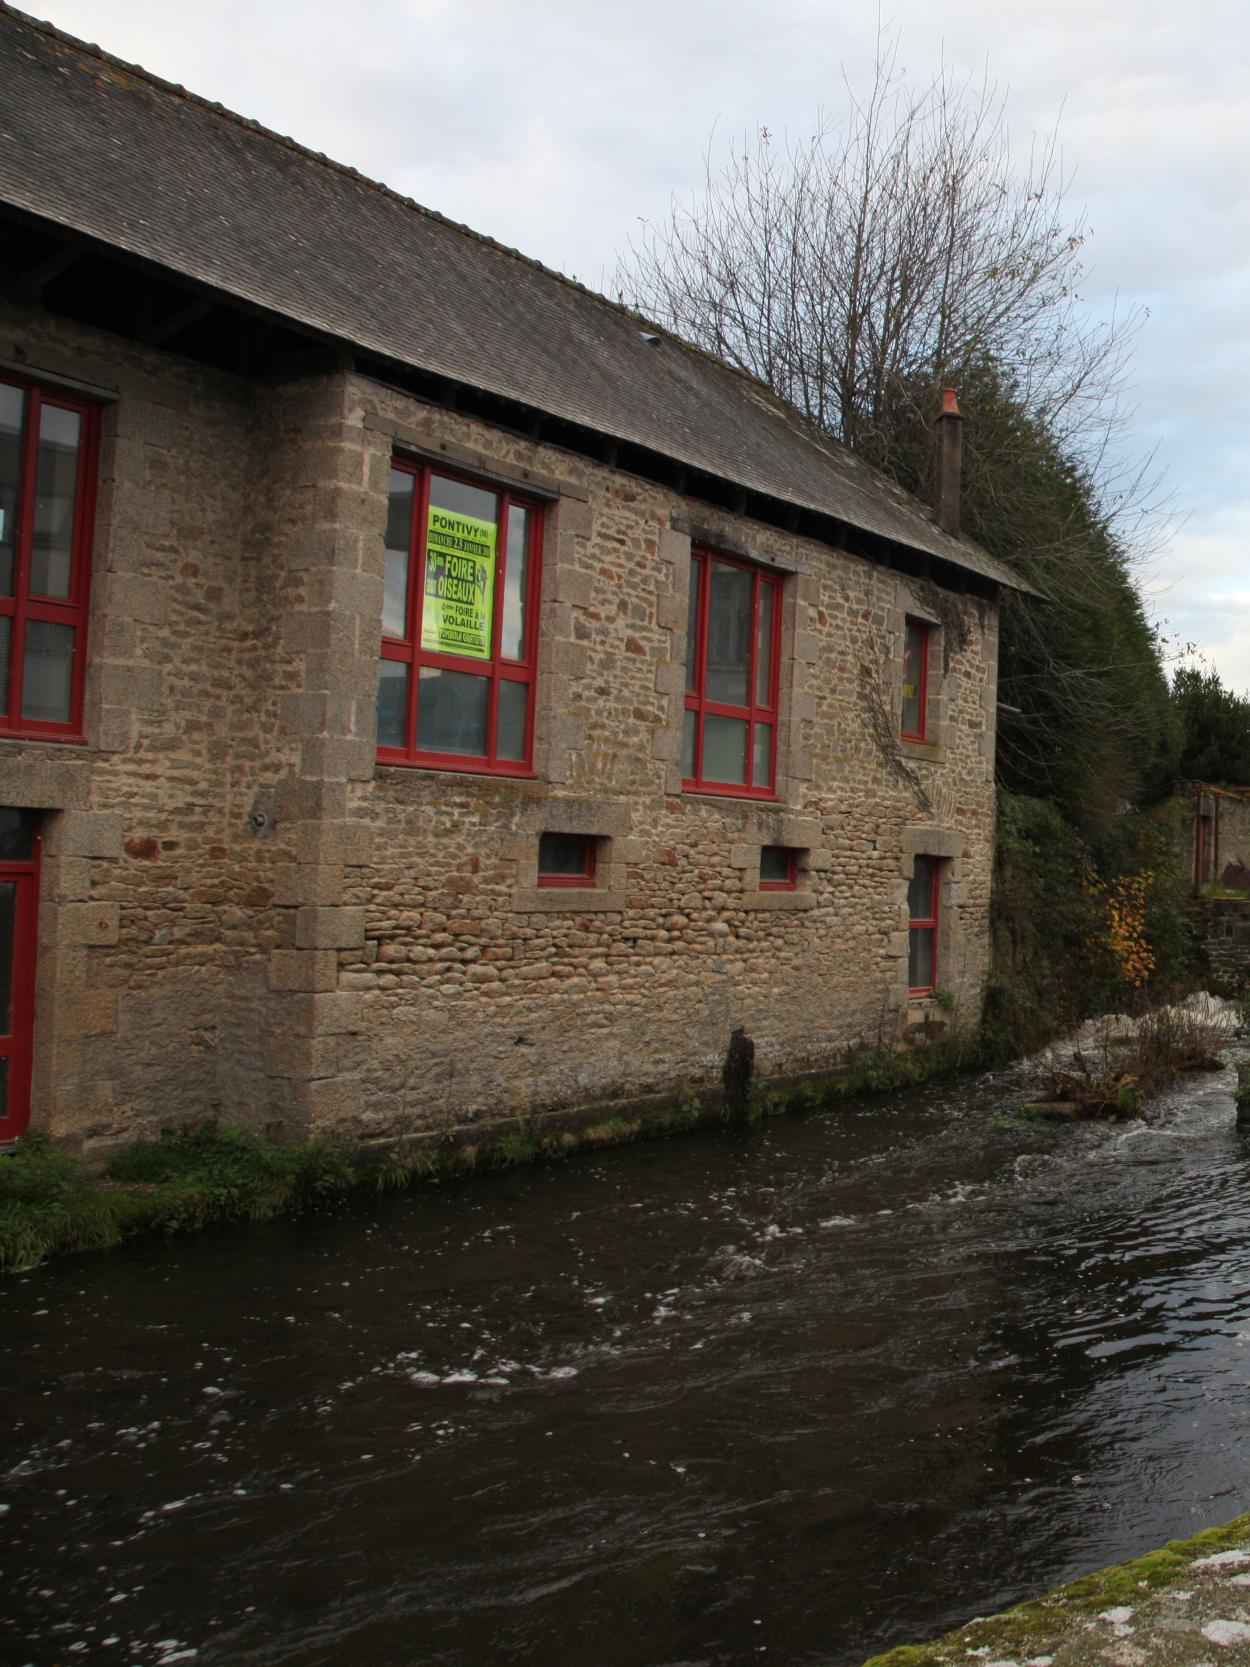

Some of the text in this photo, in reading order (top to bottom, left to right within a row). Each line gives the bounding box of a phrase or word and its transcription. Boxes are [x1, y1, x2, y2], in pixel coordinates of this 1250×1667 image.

[432, 514, 479, 538] PONTIVY
[428, 532, 453, 548] DIMANCHE
[453, 537, 463, 550] 23
[464, 541, 481, 556] JANVIER
[446, 555, 474, 581] FOIRE
[426, 575, 475, 603] aux OISEAUX
[442, 614, 485, 631] VOLAILLE
[455, 605, 474, 618] FOIRE
[480, 610, 486, 621] la
[440, 629, 463, 642] TOMBOLE
